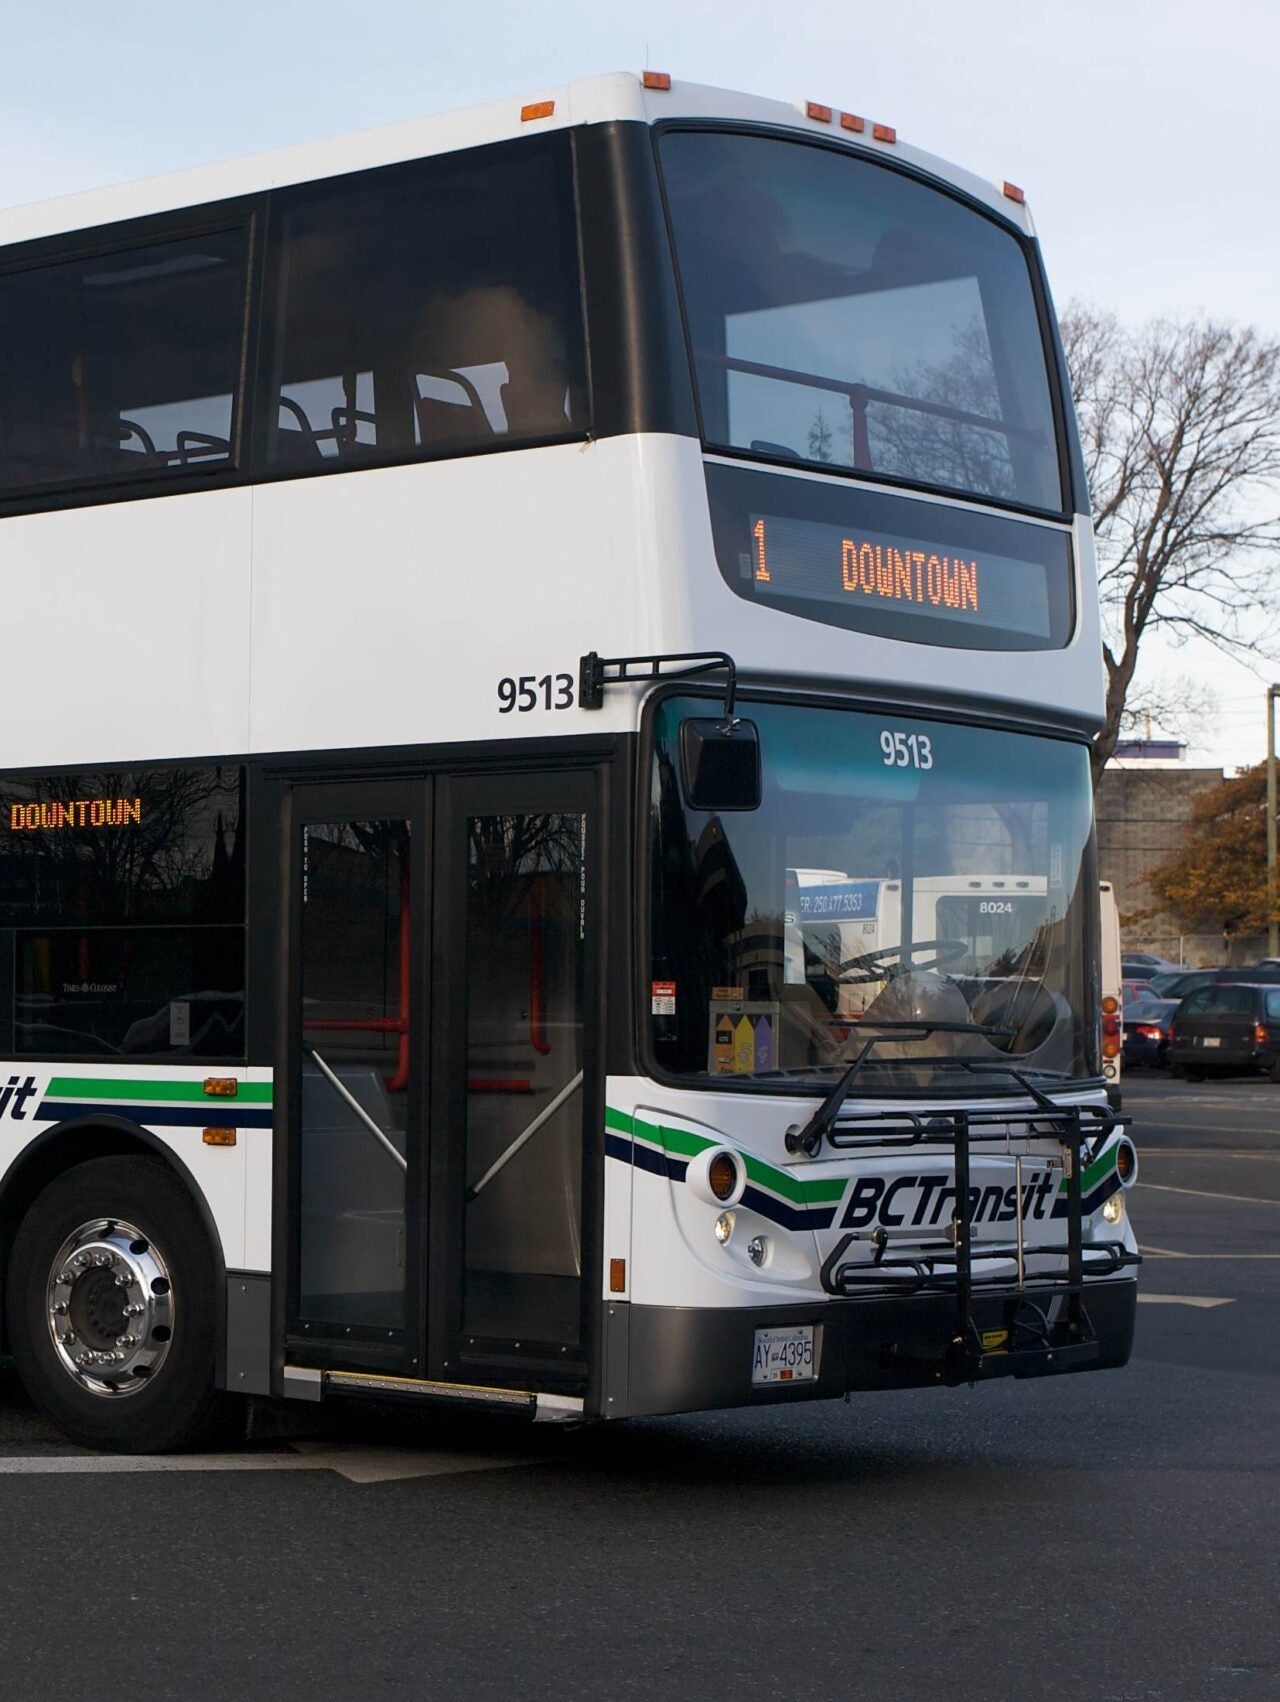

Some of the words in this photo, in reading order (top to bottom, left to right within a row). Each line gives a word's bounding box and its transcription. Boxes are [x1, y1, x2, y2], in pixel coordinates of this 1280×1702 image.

[753, 519, 770, 582] 1
[841, 537, 978, 611] DOWNTOWN
[497, 673, 574, 714] 9513
[880, 730, 933, 770] 9513
[11, 798, 141, 829] DOWNTOWN
[979, 902, 1013, 914] 8024
